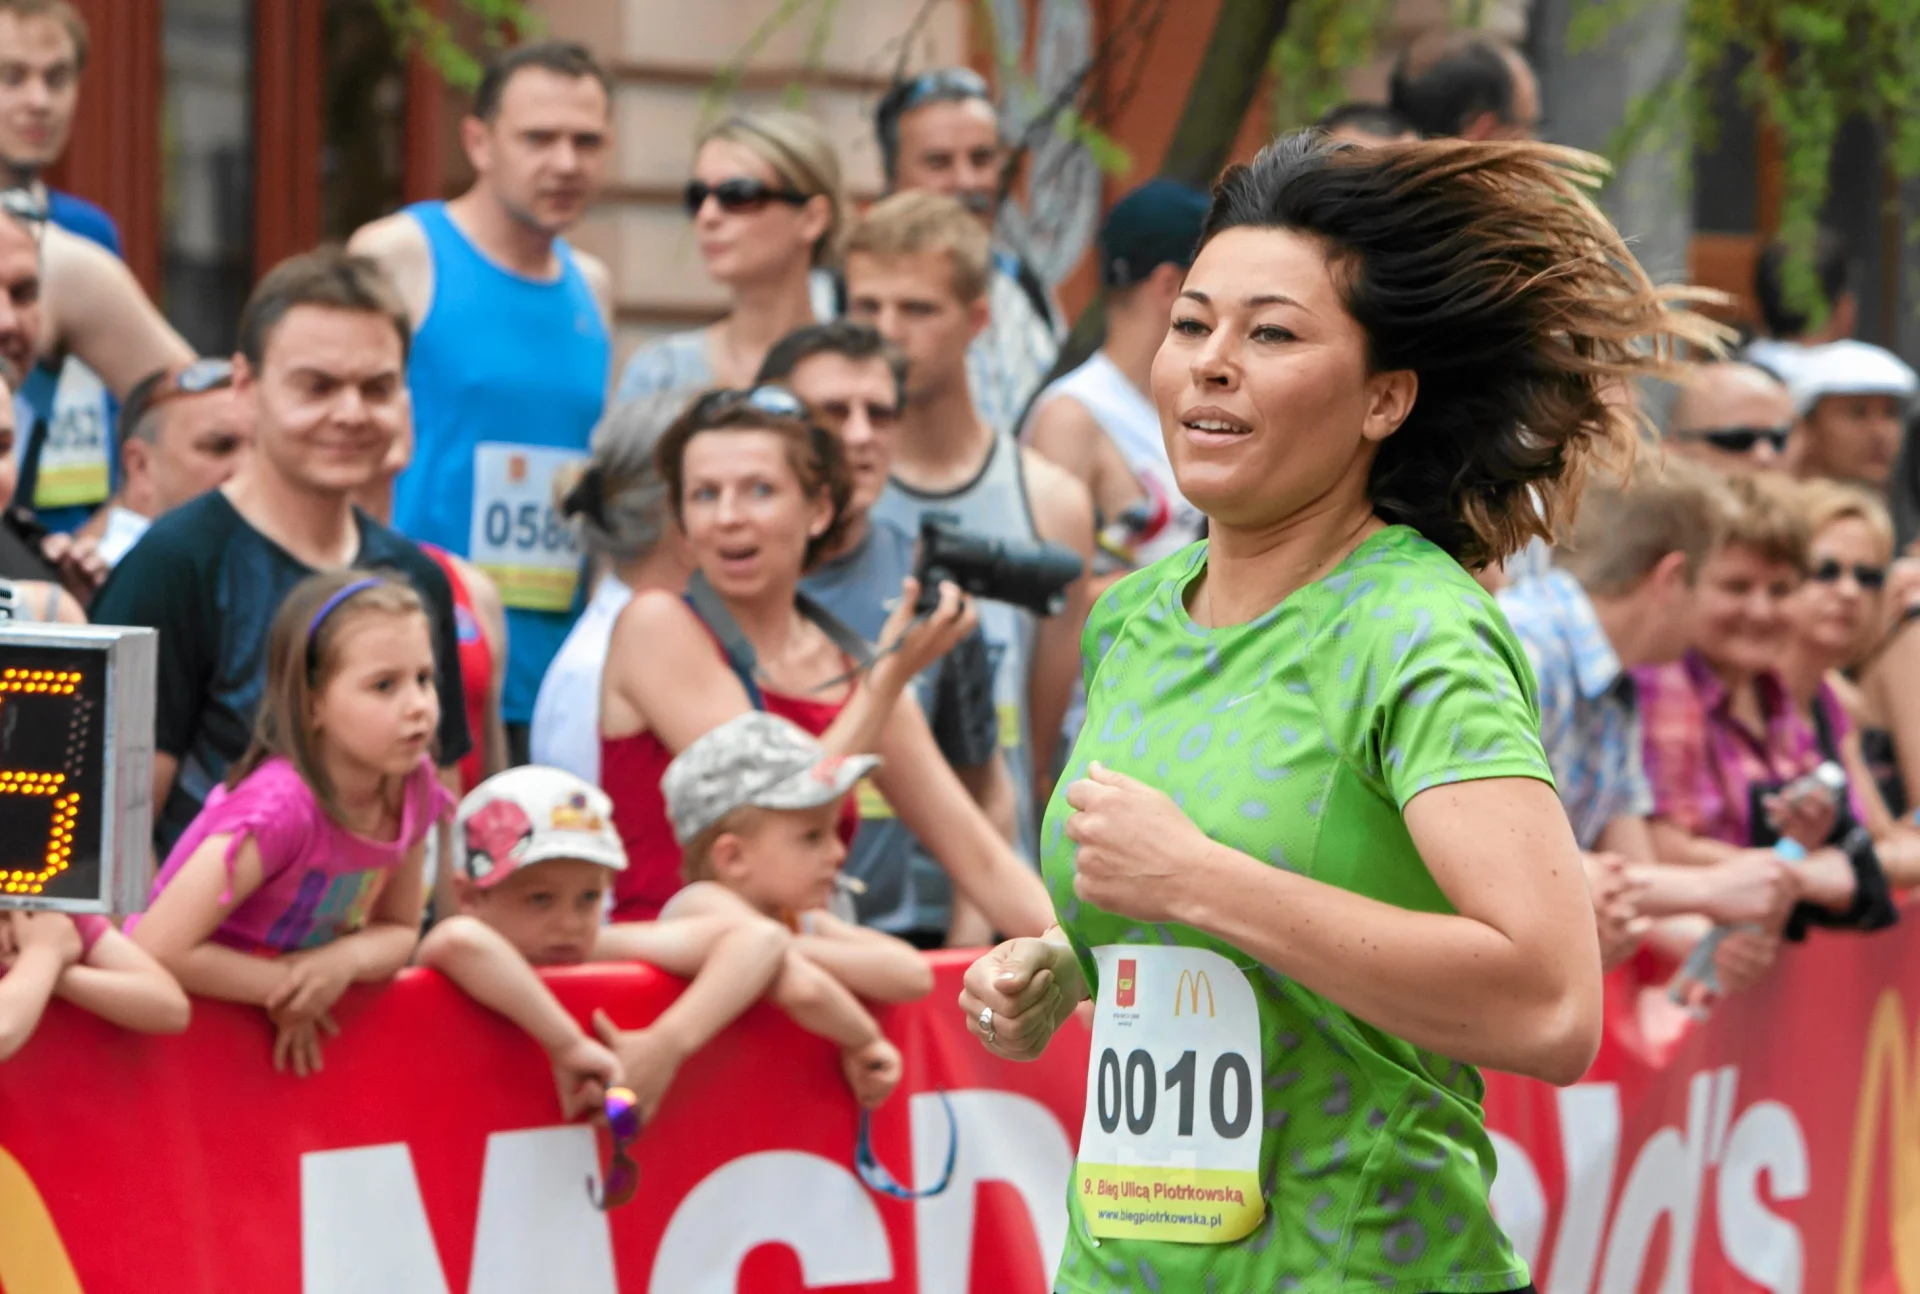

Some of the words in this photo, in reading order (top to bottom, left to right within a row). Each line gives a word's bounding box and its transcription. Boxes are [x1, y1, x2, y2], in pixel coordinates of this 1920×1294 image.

[1098, 1047, 1253, 1139] 0010
[1084, 1178, 1093, 1195] 9.
[1097, 1179, 1118, 1200] Bieg
[1121, 1181, 1151, 1203] Ulicą
[1153, 1182, 1246, 1207] Piotrkowską
[1097, 1209, 1222, 1228] www.biegpiotrkowska.pl
